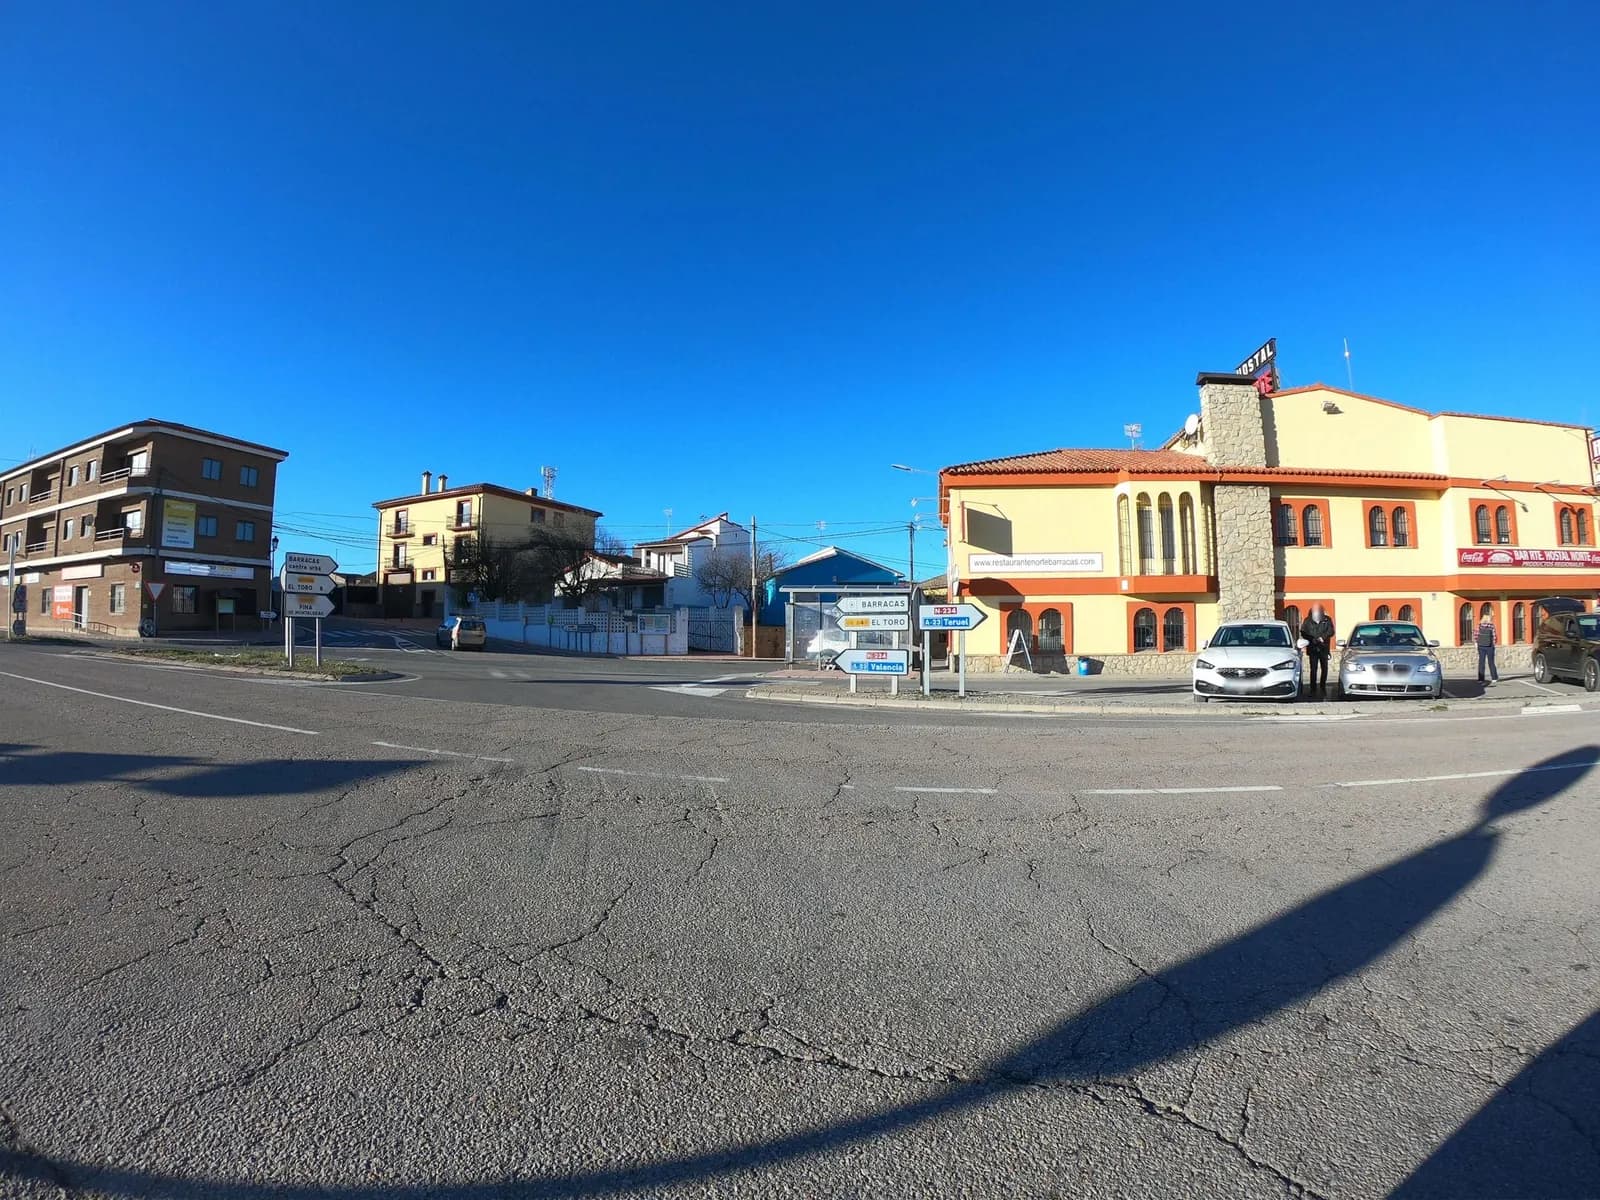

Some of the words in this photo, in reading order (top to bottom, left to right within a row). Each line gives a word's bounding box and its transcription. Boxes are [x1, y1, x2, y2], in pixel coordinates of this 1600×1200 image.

[288, 555, 320, 564] BARRACAS
[1513, 550, 1528, 561] BAR
[1544, 550, 1571, 562] HOSTAL
[1570, 551, 1592, 562] NORTE
[973, 558, 1097, 568] www.restaurantenortebarracas.com
[861, 600, 905, 608] BARRACAS
[871, 618, 881, 626] EL
[883, 618, 905, 626] TORO
[924, 618, 941, 626] A-23
[942, 617, 969, 627] Teruel
[870, 663, 903, 672] Valencia
